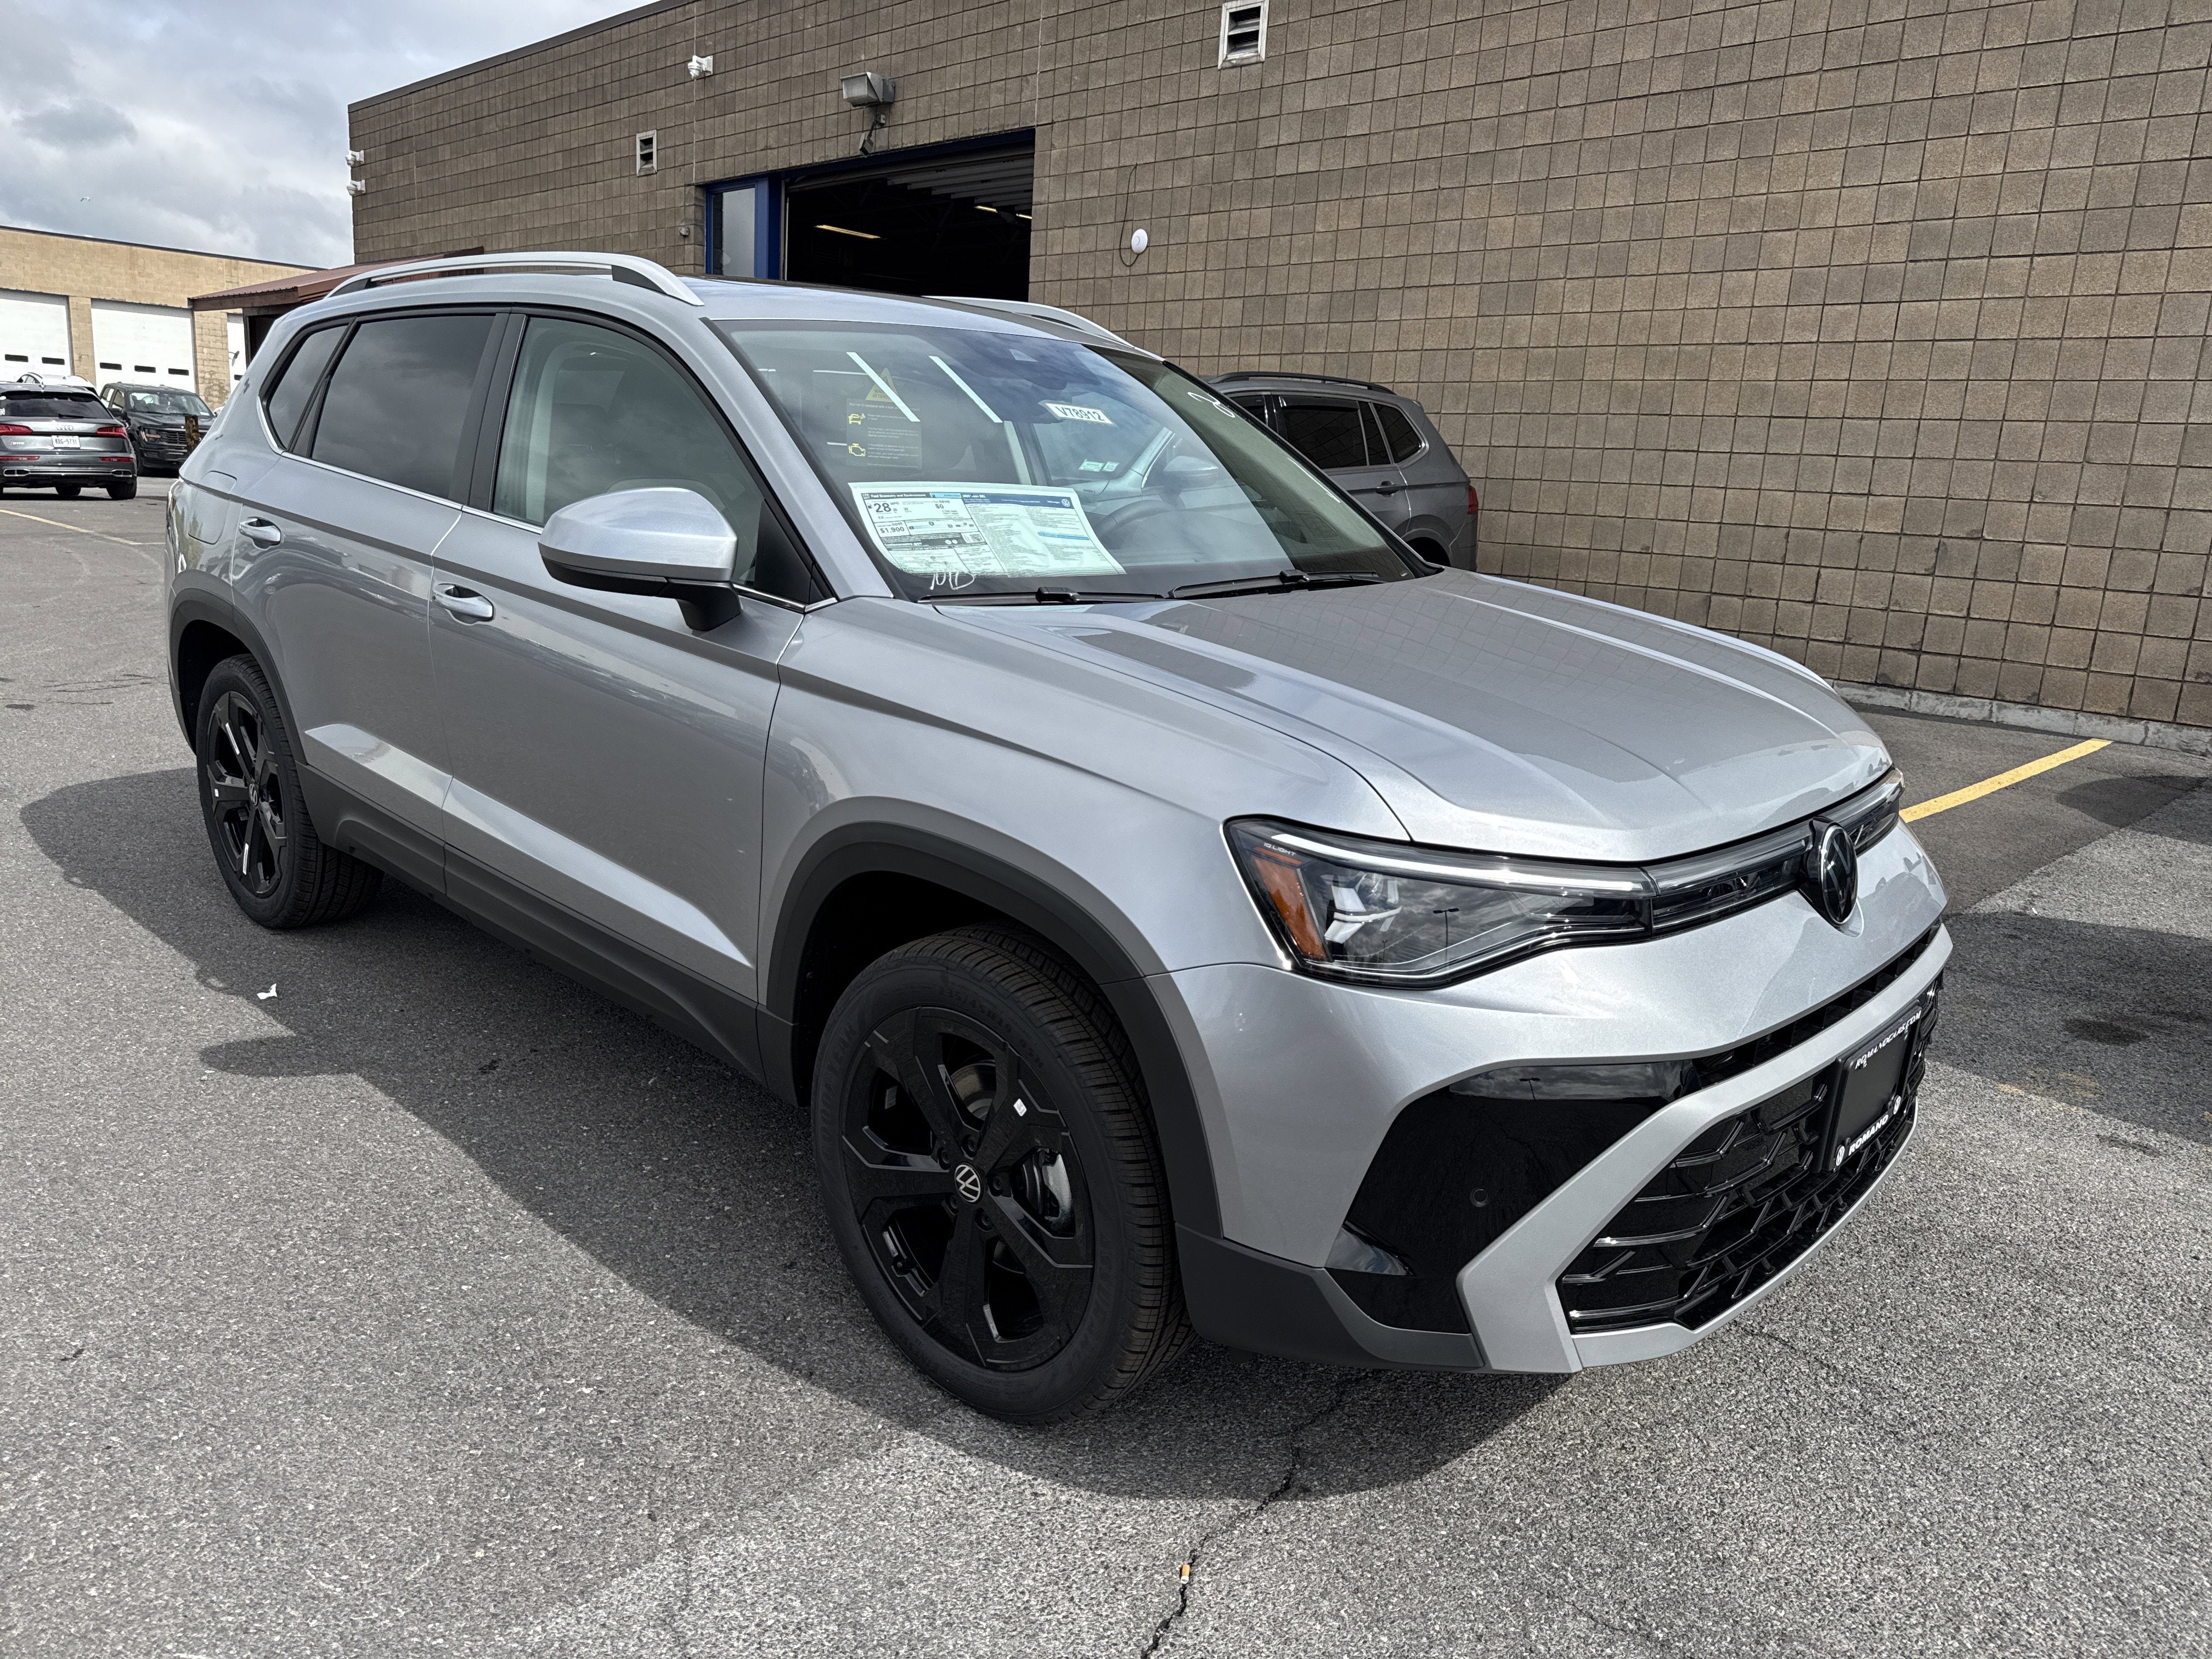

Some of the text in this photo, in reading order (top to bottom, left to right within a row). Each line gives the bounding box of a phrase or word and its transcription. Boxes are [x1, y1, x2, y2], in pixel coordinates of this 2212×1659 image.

[1056, 406, 1105, 421] V78912
[873, 503, 891, 512] 28
[1848, 1114, 1889, 1156] ROMANO
